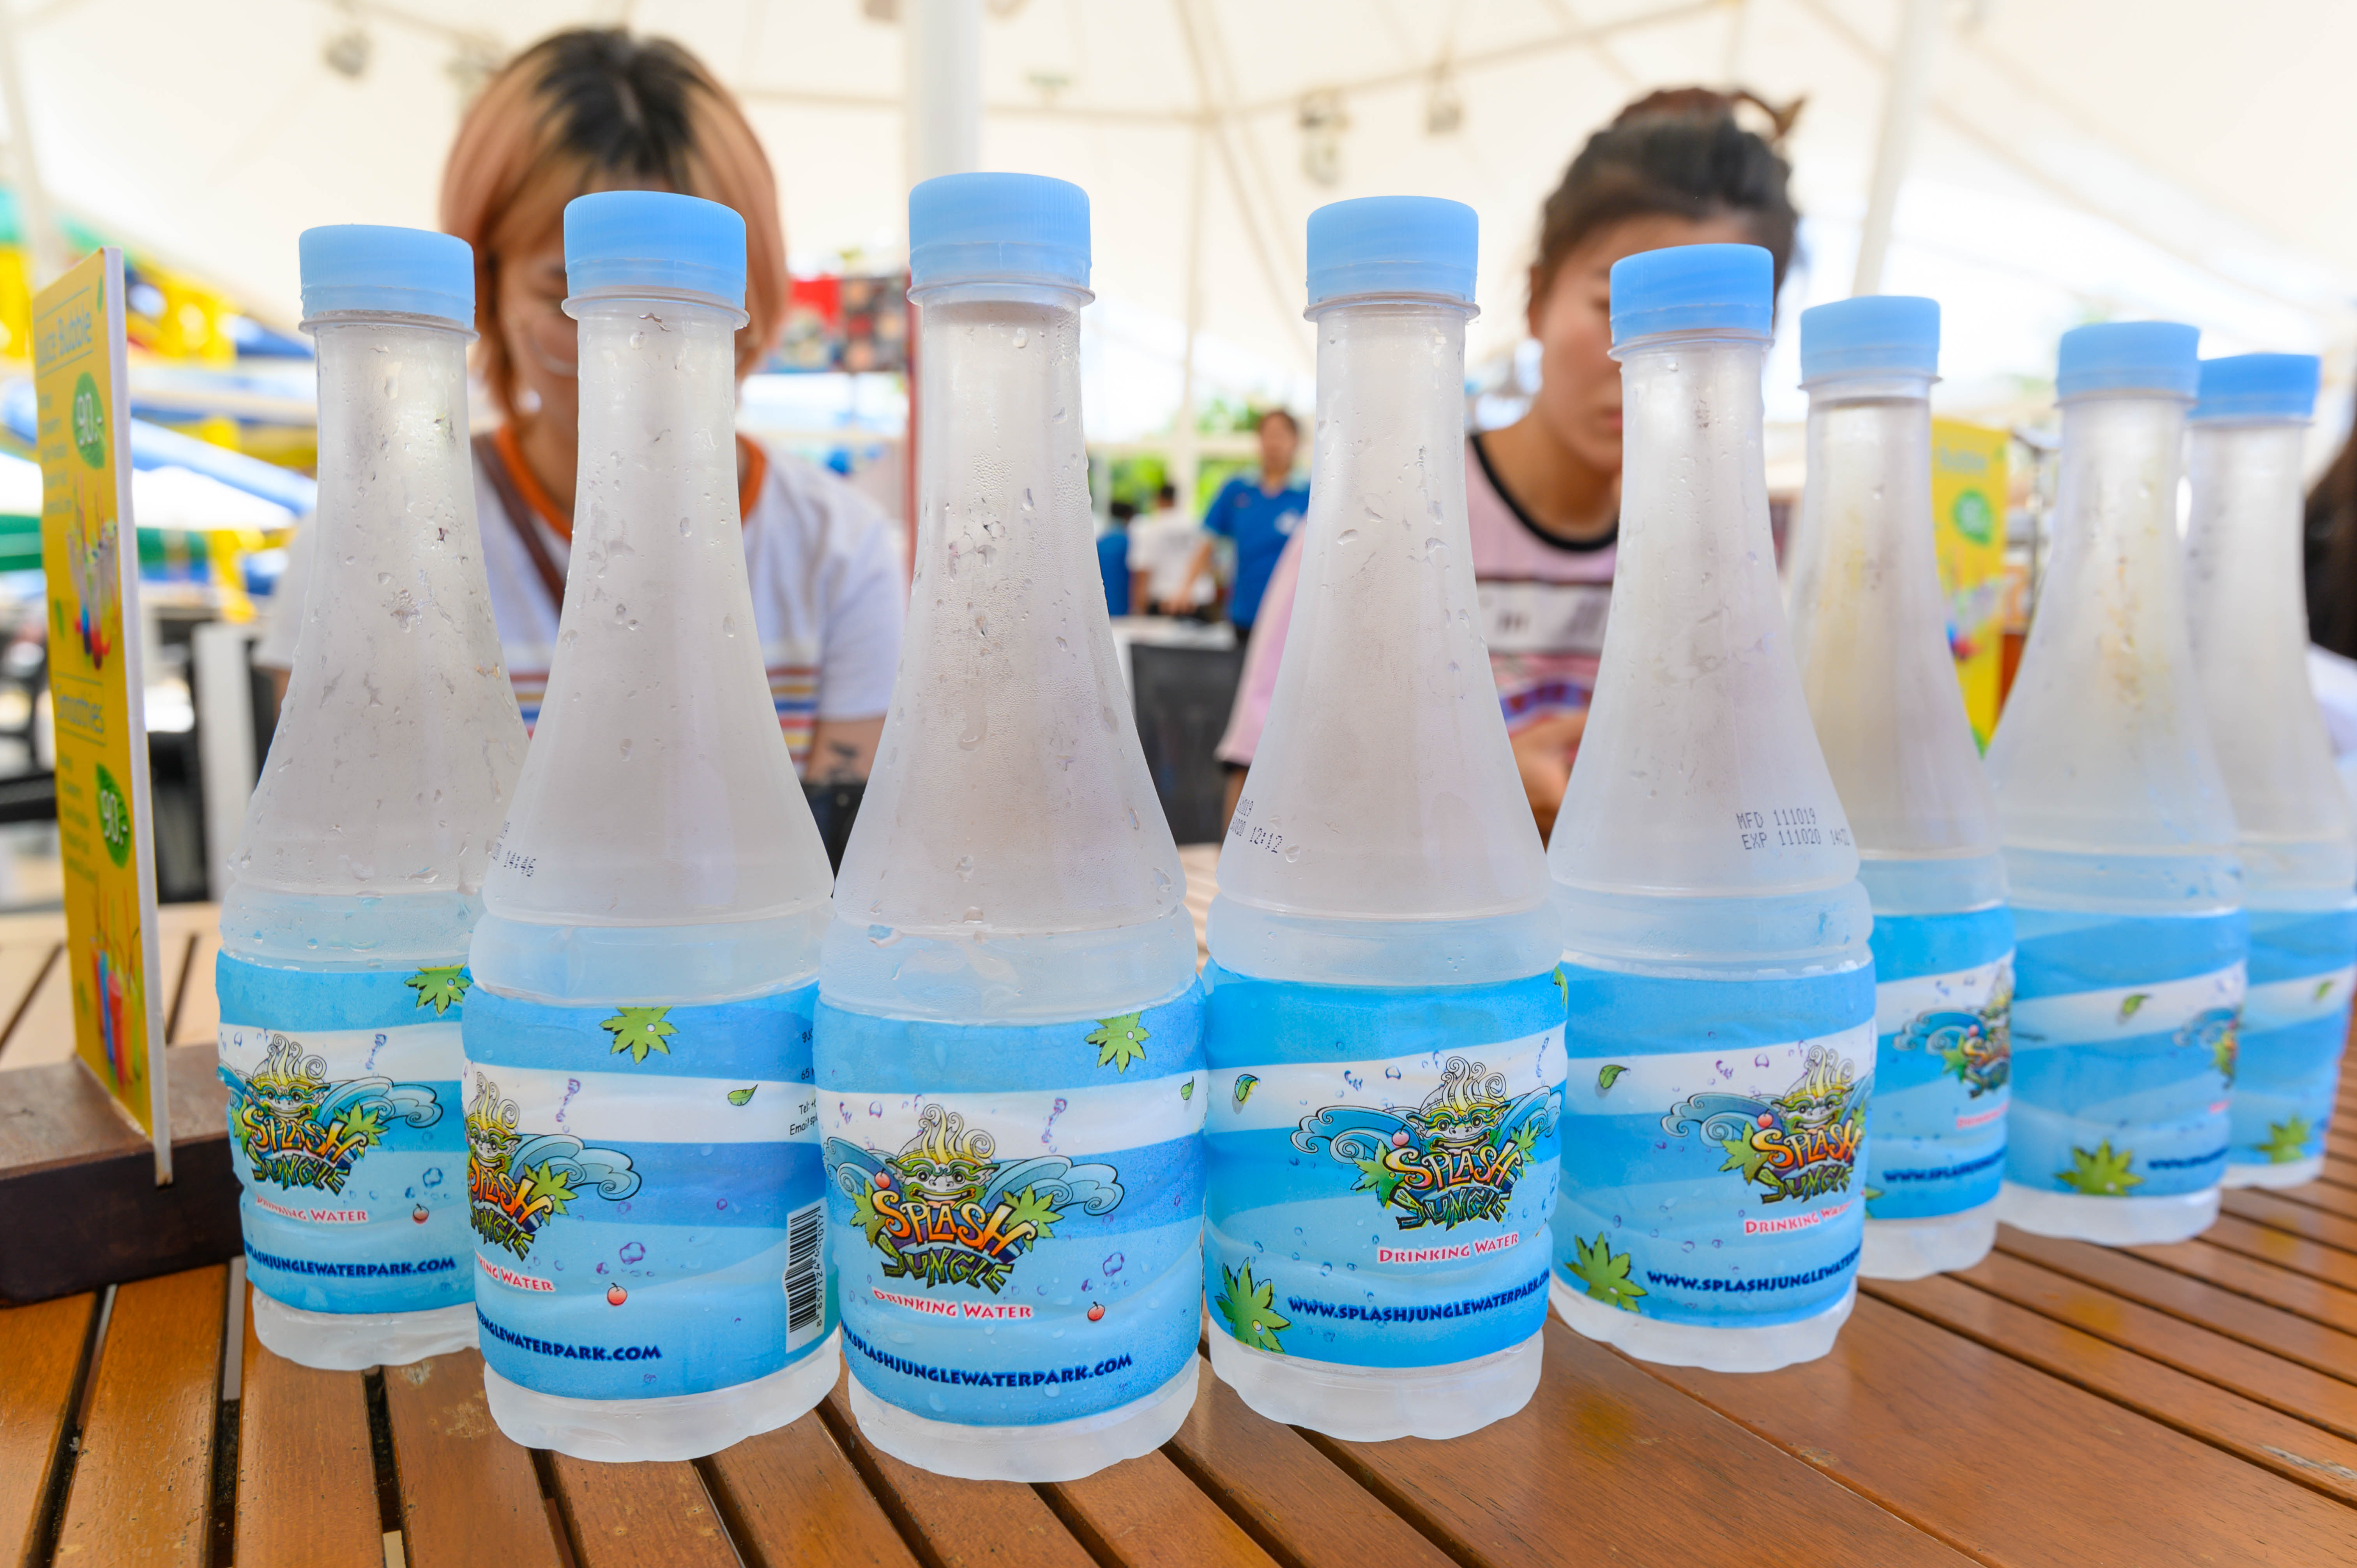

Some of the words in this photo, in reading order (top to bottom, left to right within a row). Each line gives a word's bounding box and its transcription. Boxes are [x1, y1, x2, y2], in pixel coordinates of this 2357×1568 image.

[1736, 811, 1764, 830] MFD
[1774, 807, 1816, 826] 111019
[1249, 826, 1283, 854] 12:12
[1741, 832, 1767, 850] EXP
[1779, 828, 1822, 846] 111020
[801, 1068, 809, 1080] 65
[799, 1101, 810, 1115] Tel:
[242, 1105, 369, 1164] SPLASH
[1749, 1118, 1863, 1169] SPLASH
[247, 1142, 352, 1197] JUNGLE
[1382, 1139, 1523, 1192] SPLASH
[1754, 1164, 1854, 1204] JUNGLE
[310, 1209, 367, 1222] WATER
[1389, 1182, 1512, 1232] JUNGLE
[871, 1188, 1038, 1259] SPLASH
[1745, 1213, 1819, 1233] DRINKING
[875, 1230, 1014, 1294] JUNGLE
[1380, 1246, 1470, 1263] DRINKING
[1474, 1234, 1518, 1254] WATER
[500, 1268, 553, 1291] WATER
[873, 1289, 957, 1317] DRINKING
[963, 1303, 1032, 1319] WATER
